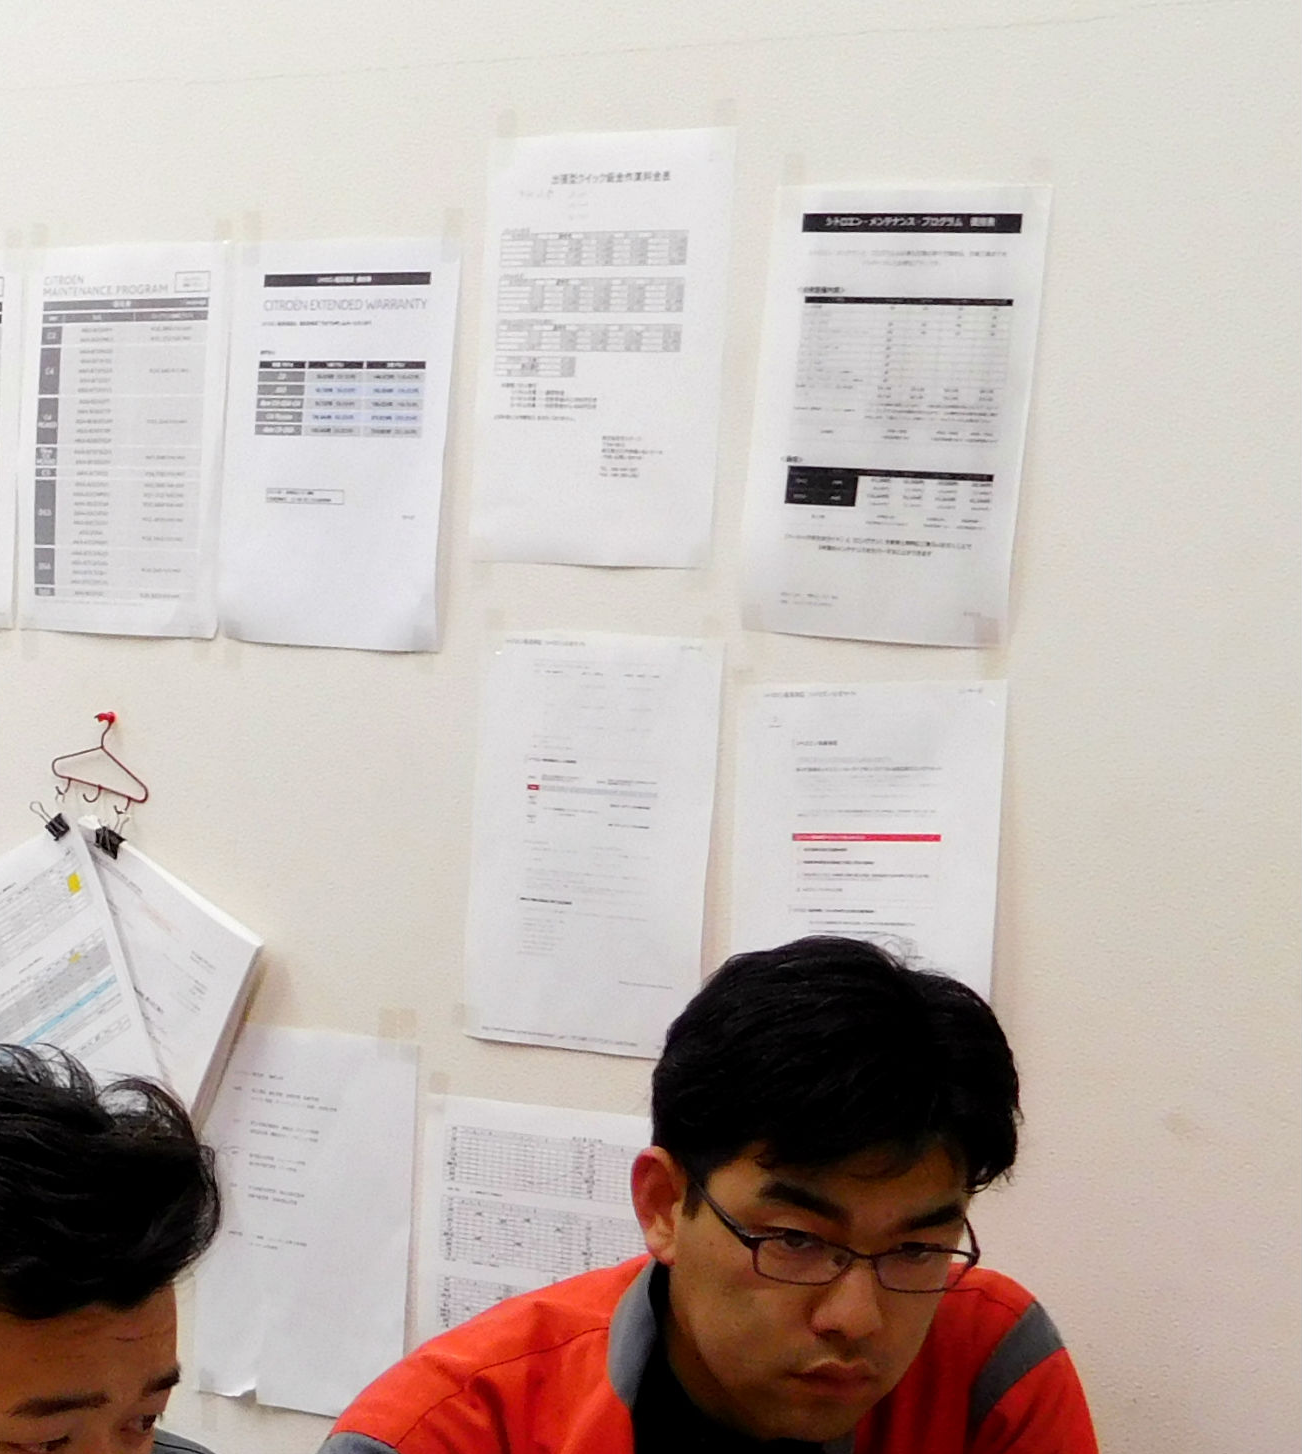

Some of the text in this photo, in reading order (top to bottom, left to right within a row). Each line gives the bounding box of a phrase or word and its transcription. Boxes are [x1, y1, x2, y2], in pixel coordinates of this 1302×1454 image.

[43, 283, 169, 297] MAINTENANCE PROGRAM
[310, 299, 363, 311] EXTENDED
[366, 298, 428, 310] WARRANTY
